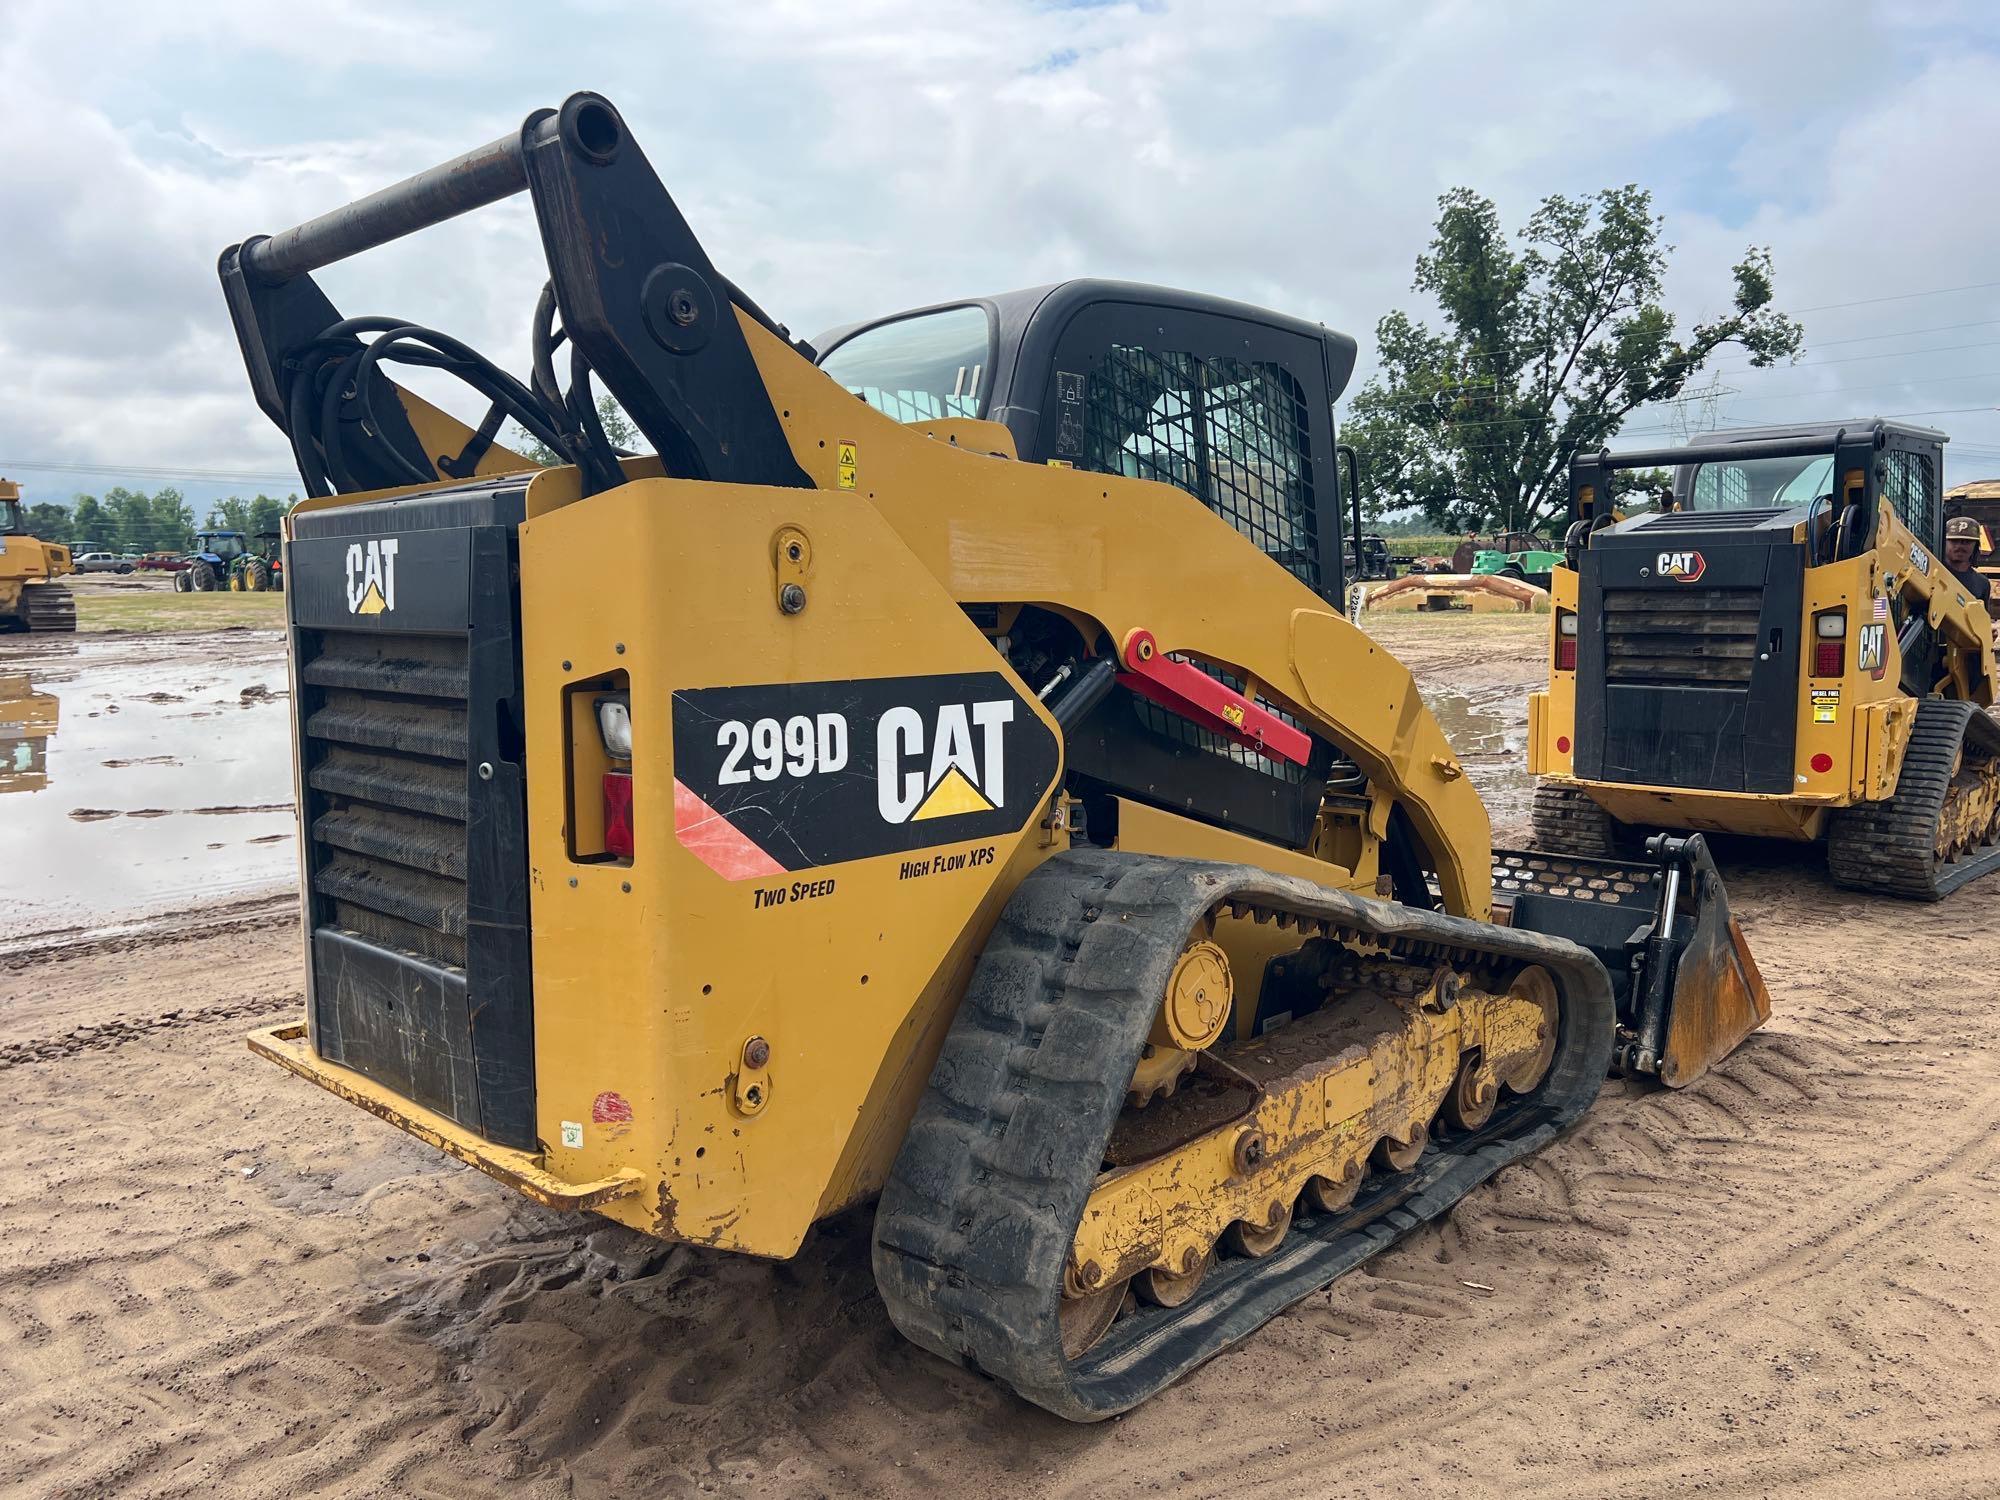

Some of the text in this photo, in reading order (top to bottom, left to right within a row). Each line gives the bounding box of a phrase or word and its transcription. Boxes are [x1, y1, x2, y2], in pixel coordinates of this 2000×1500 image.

[345, 538, 399, 614] CAT
[1657, 553, 1694, 575] CAT
[1859, 624, 1884, 670] CAT
[716, 699, 1014, 825] 299D CAT
[899, 846, 995, 880] HIGH FLOW XPS
[754, 879, 835, 909] TWO SPEED
